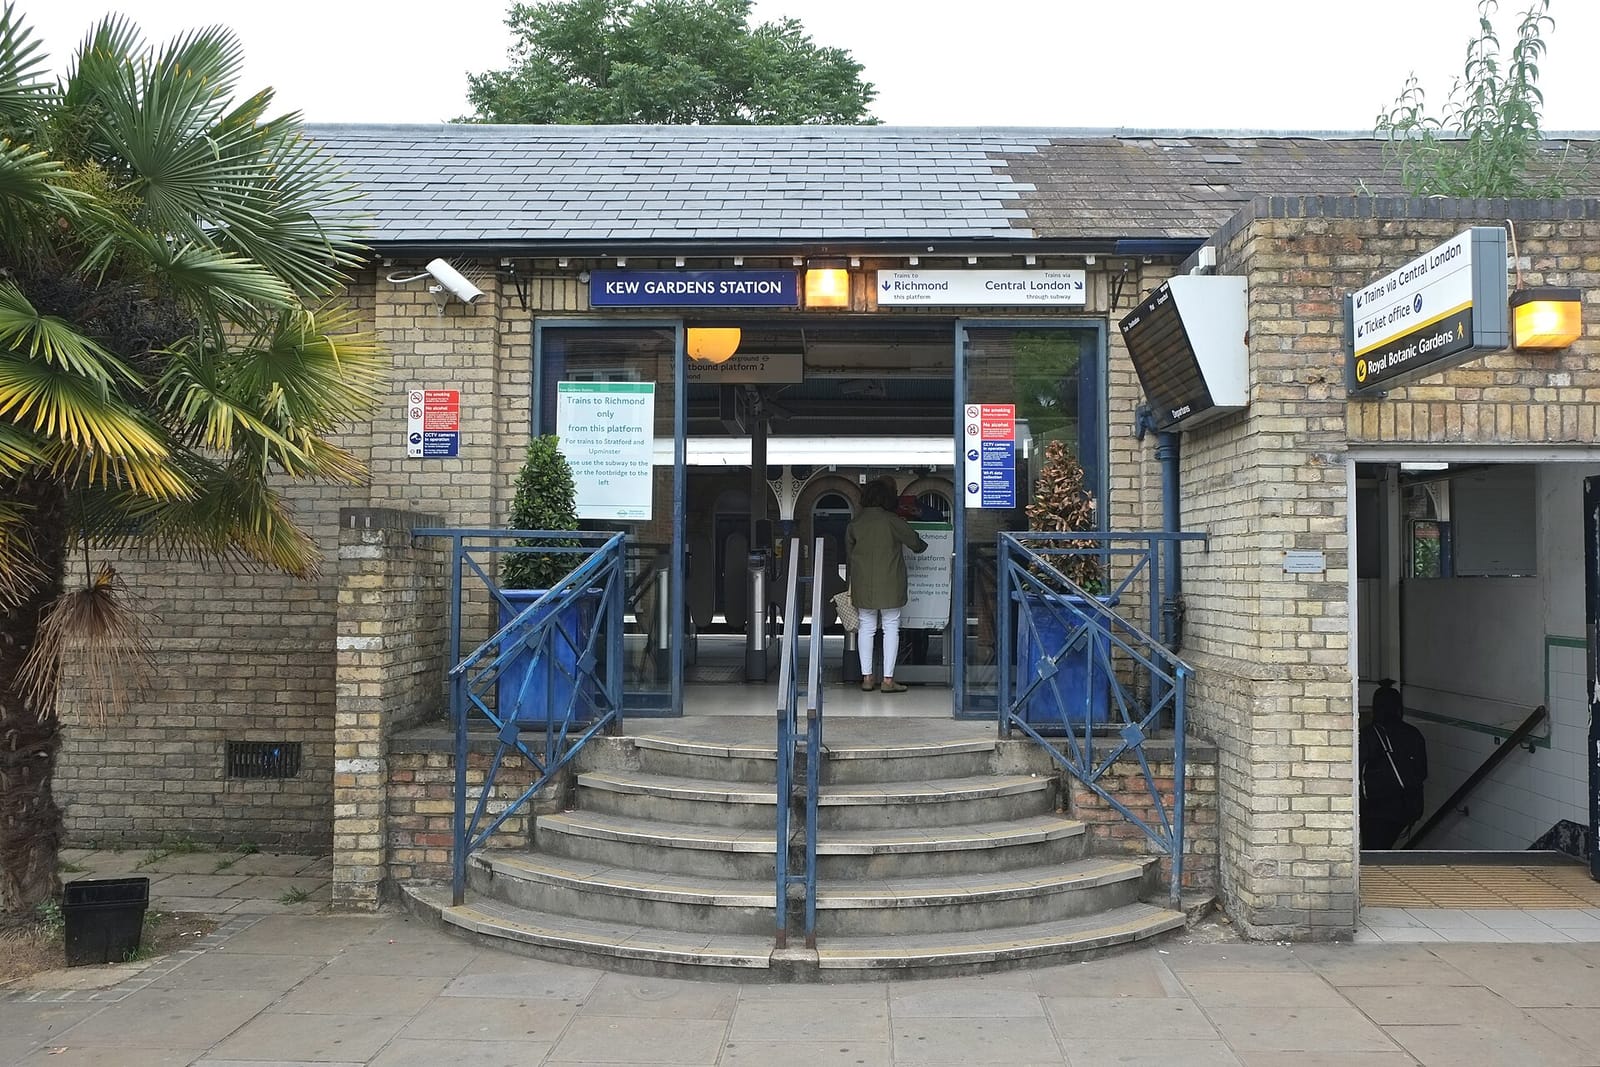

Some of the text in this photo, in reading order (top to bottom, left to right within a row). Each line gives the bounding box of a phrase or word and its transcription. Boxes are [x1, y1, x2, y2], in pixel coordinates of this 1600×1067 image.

[1364, 244, 1462, 305] Trains via Central London
[606, 281, 782, 294] KEW GARDENS STATION
[894, 280, 948, 290] Richmond
[985, 280, 1071, 290] Central London
[1365, 304, 1411, 335] Ticket office
[1368, 330, 1454, 375] Royal Botanic Gardens
[720, 363, 757, 372] platform
[605, 396, 645, 405] Richmond
[597, 410, 614, 419] only
[607, 425, 642, 434] platform
